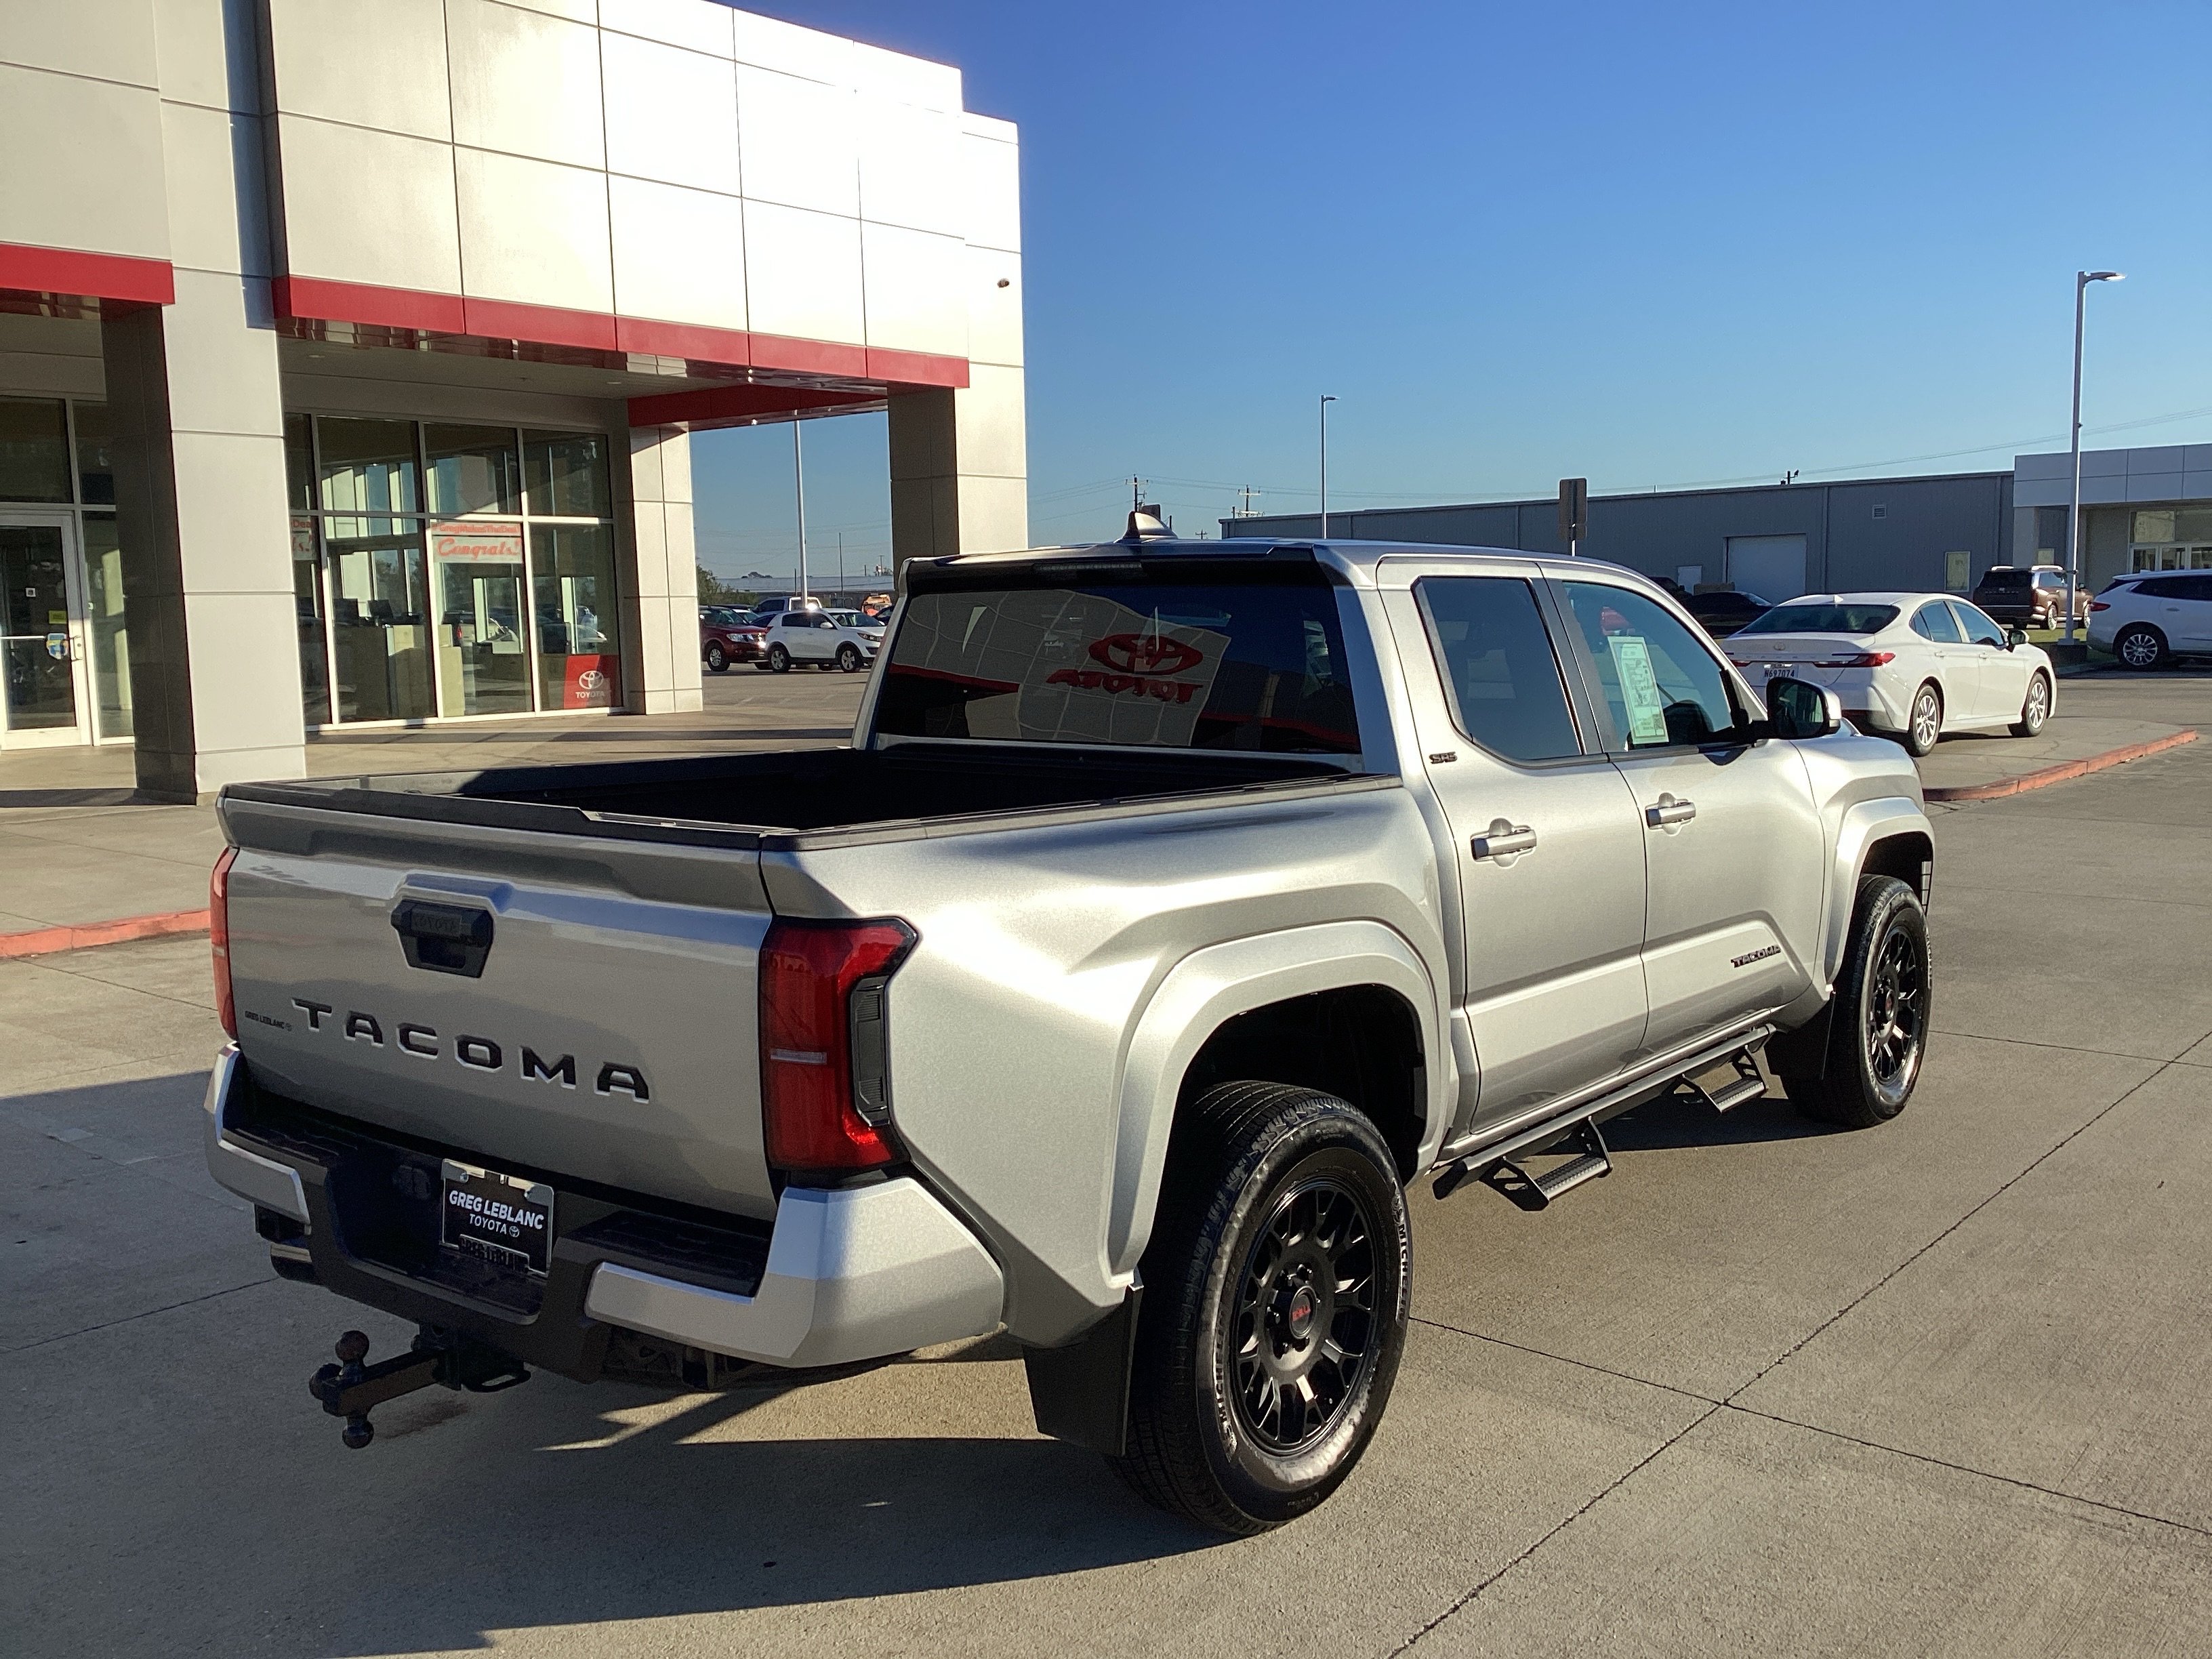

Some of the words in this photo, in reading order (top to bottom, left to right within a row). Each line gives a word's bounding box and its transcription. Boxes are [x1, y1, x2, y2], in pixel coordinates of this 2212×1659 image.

[1731, 945, 1781, 968] TACOMA
[291, 998, 649, 1103] TACOMA
[449, 1190, 482, 1212] GREG
[483, 1200, 544, 1229] LEBLANC
[469, 1214, 507, 1235] TOYOTA
[1398, 1224, 1408, 1320] MICHELIN
